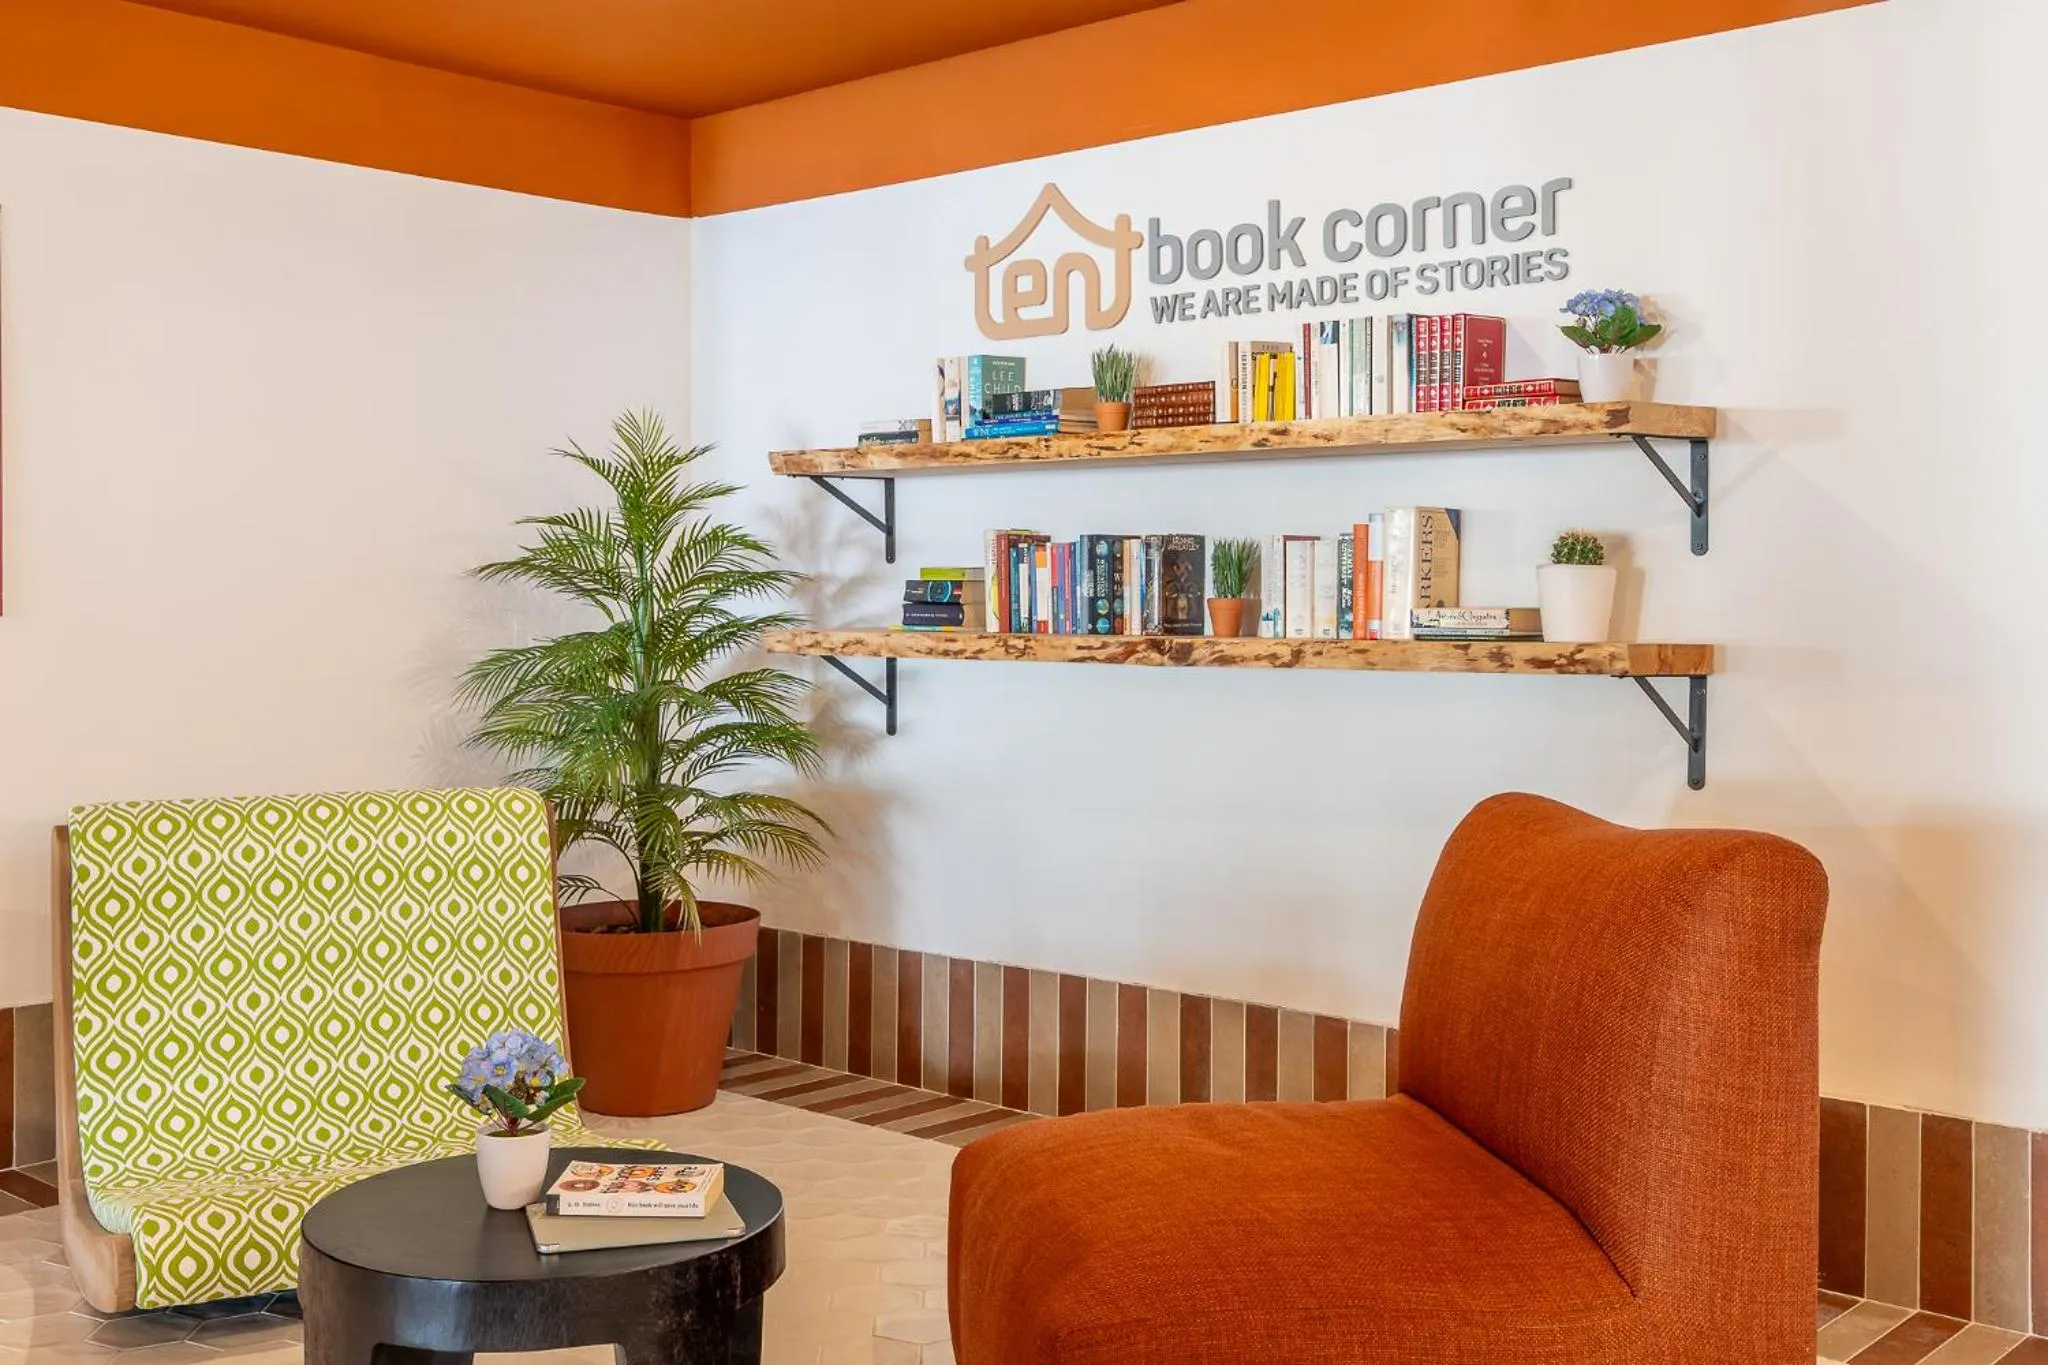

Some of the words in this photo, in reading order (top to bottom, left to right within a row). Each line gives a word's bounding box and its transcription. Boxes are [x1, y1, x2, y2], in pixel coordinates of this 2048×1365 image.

[964, 182, 1143, 340] tent
[1148, 199, 1306, 285] book
[1322, 177, 1573, 263] corner
[1149, 292, 1197, 324] WE
[1199, 284, 1262, 319] ARE
[1267, 272, 1360, 312] MADE
[1365, 266, 1411, 301] OF
[1415, 247, 1570, 296] STORIES
[984, 382, 1021, 395] CHILD
[991, 370, 1015, 382] LEE
[1420, 514, 1434, 609] RKERS
